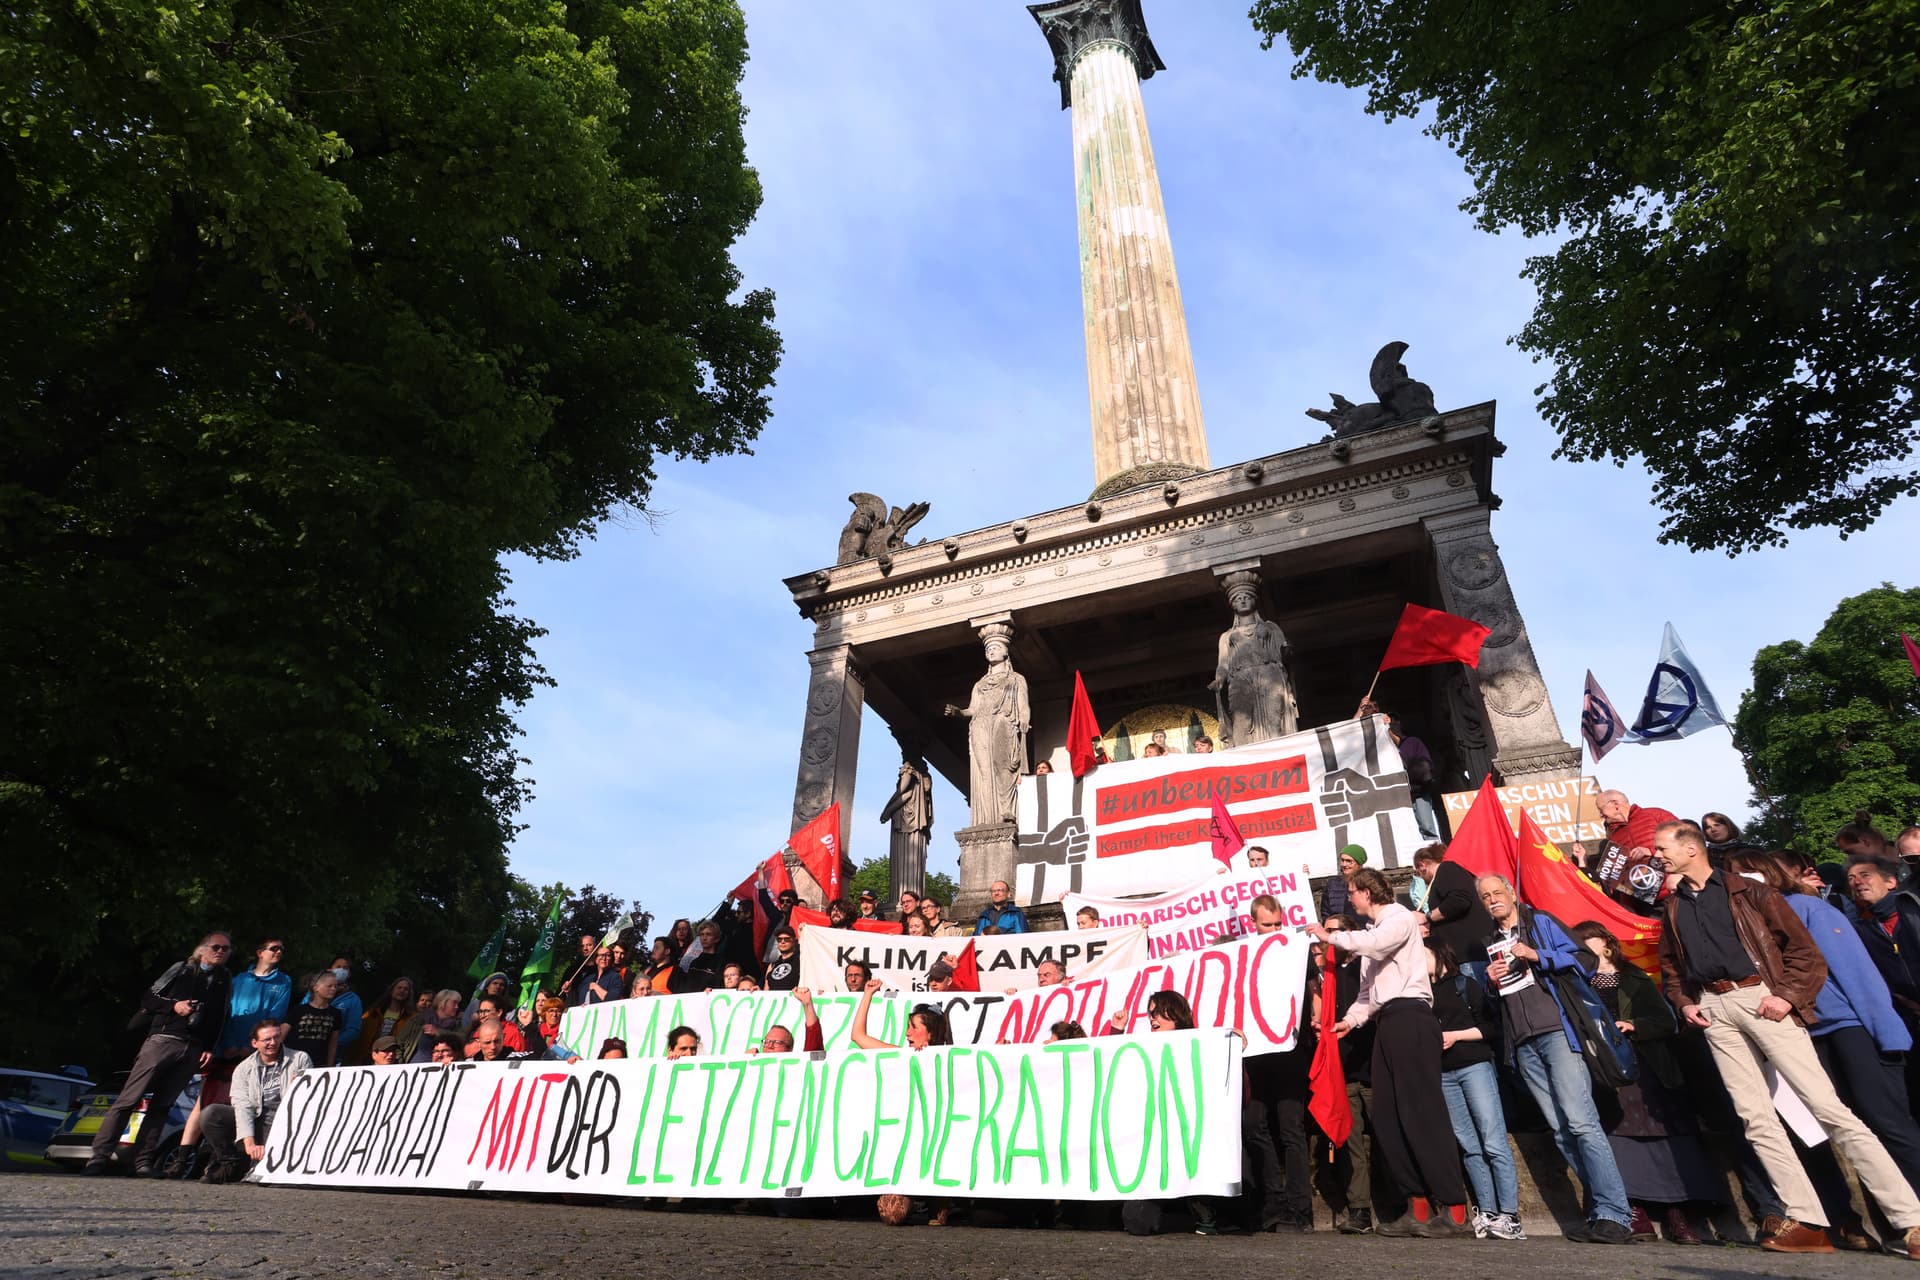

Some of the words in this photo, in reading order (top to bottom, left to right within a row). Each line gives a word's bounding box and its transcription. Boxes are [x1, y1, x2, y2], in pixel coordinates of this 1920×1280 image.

[1102, 766, 1303, 816] #unbeugsam
[1445, 776, 1599, 811] KLASCHUTZ
[1100, 833, 1148, 853] Kampf
[1154, 829, 1193, 846] ihrer
[1197, 810, 1313, 839] Klenjustiz!
[1600, 859, 1614, 881] NOW
[1608, 845, 1620, 858] OR
[1610, 853, 1628, 880] NEVER
[709, 992, 912, 1056] SCHÜTZN
[943, 997, 1005, 1046] ST
[266, 1064, 476, 1177] SOLIDARITÄT
[467, 1073, 569, 1174] MIT
[546, 1070, 621, 1180] DER
[627, 1057, 828, 1189] LETZTEN
[832, 1039, 1204, 1193] GENERATION
